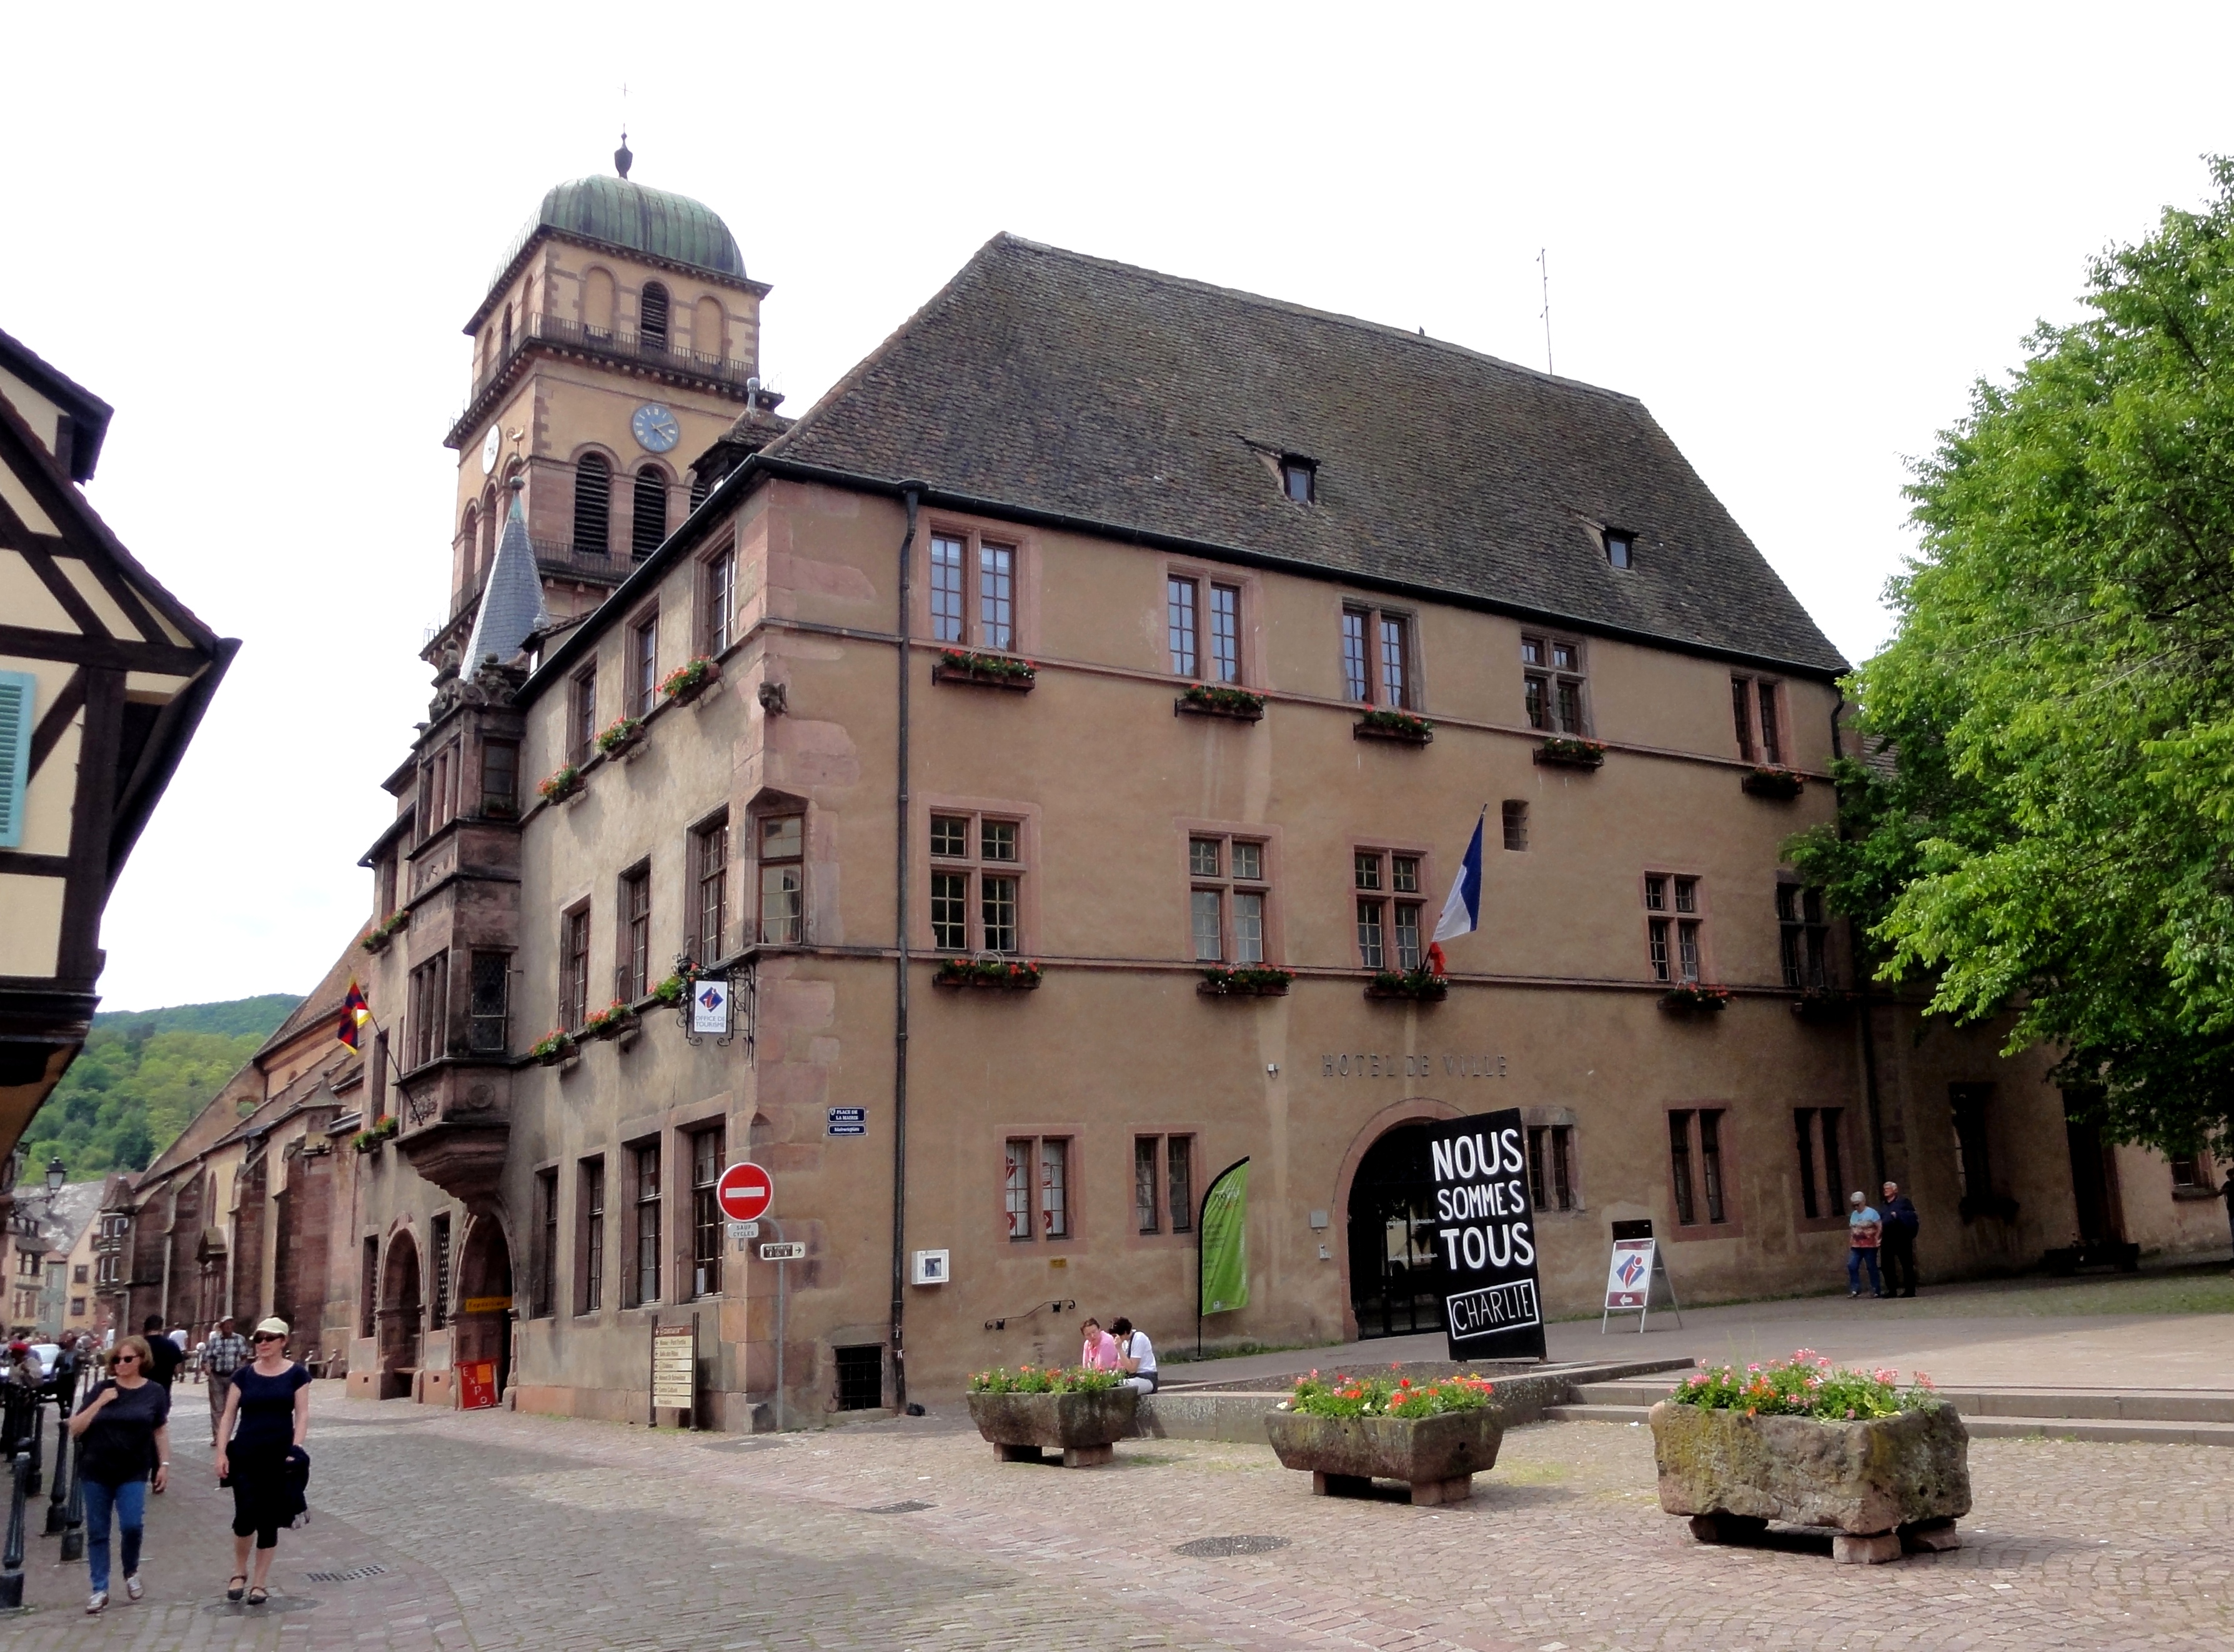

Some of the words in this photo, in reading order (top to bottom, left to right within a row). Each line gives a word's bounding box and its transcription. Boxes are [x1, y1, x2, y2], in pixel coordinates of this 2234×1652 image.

[1322, 1054, 1395, 1077] HOTEL
[1406, 1055, 1429, 1077] DE
[1442, 1055, 1507, 1077] VILLE
[1432, 1128, 1523, 1182] NOUS
[1437, 1180, 1525, 1221] SOMMES
[1439, 1222, 1534, 1270] TOUS
[1452, 1284, 1533, 1331] CHARLIE
